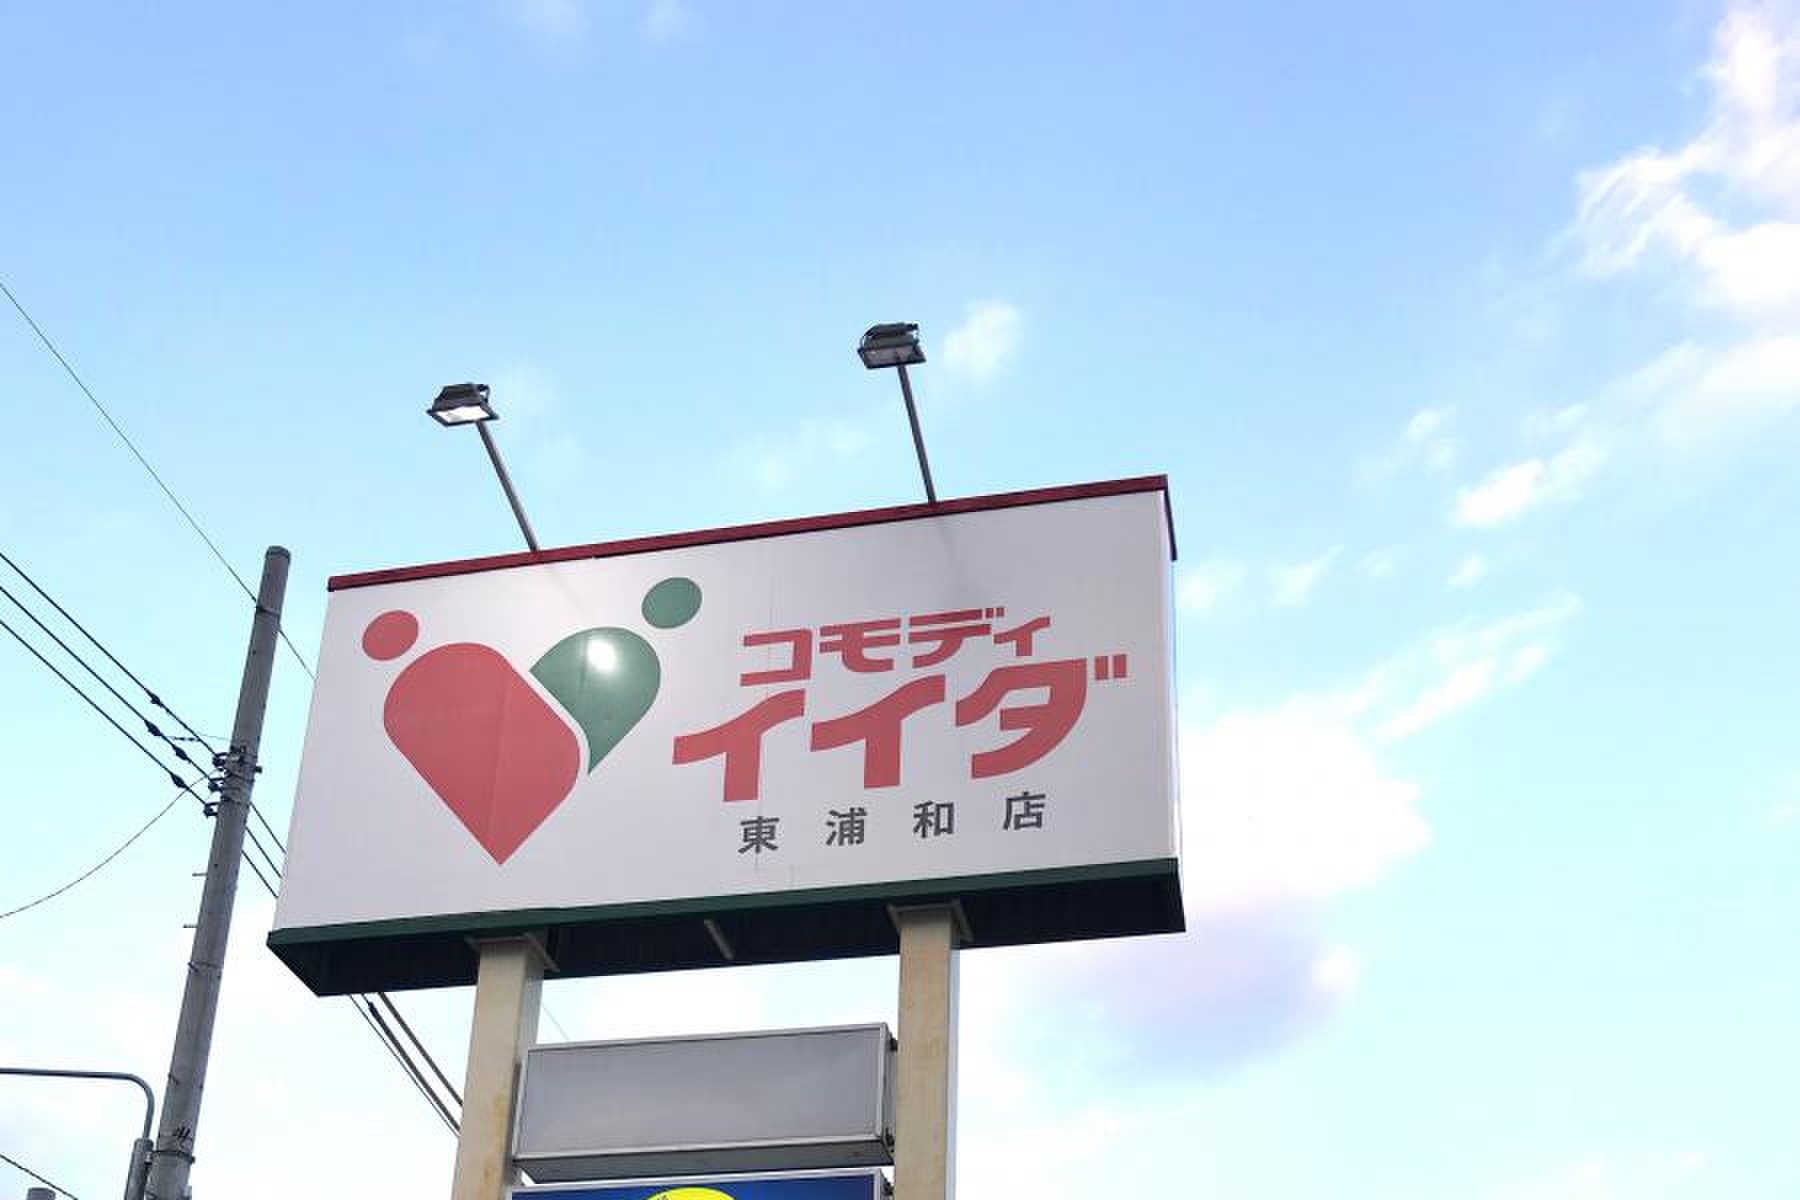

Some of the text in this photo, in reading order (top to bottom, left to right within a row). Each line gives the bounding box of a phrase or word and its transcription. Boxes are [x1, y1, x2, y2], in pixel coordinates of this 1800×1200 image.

[740, 606, 1051, 687] コモディ
[672, 653, 1128, 802] イイダ
[738, 791, 1047, 855] 東浦和店
